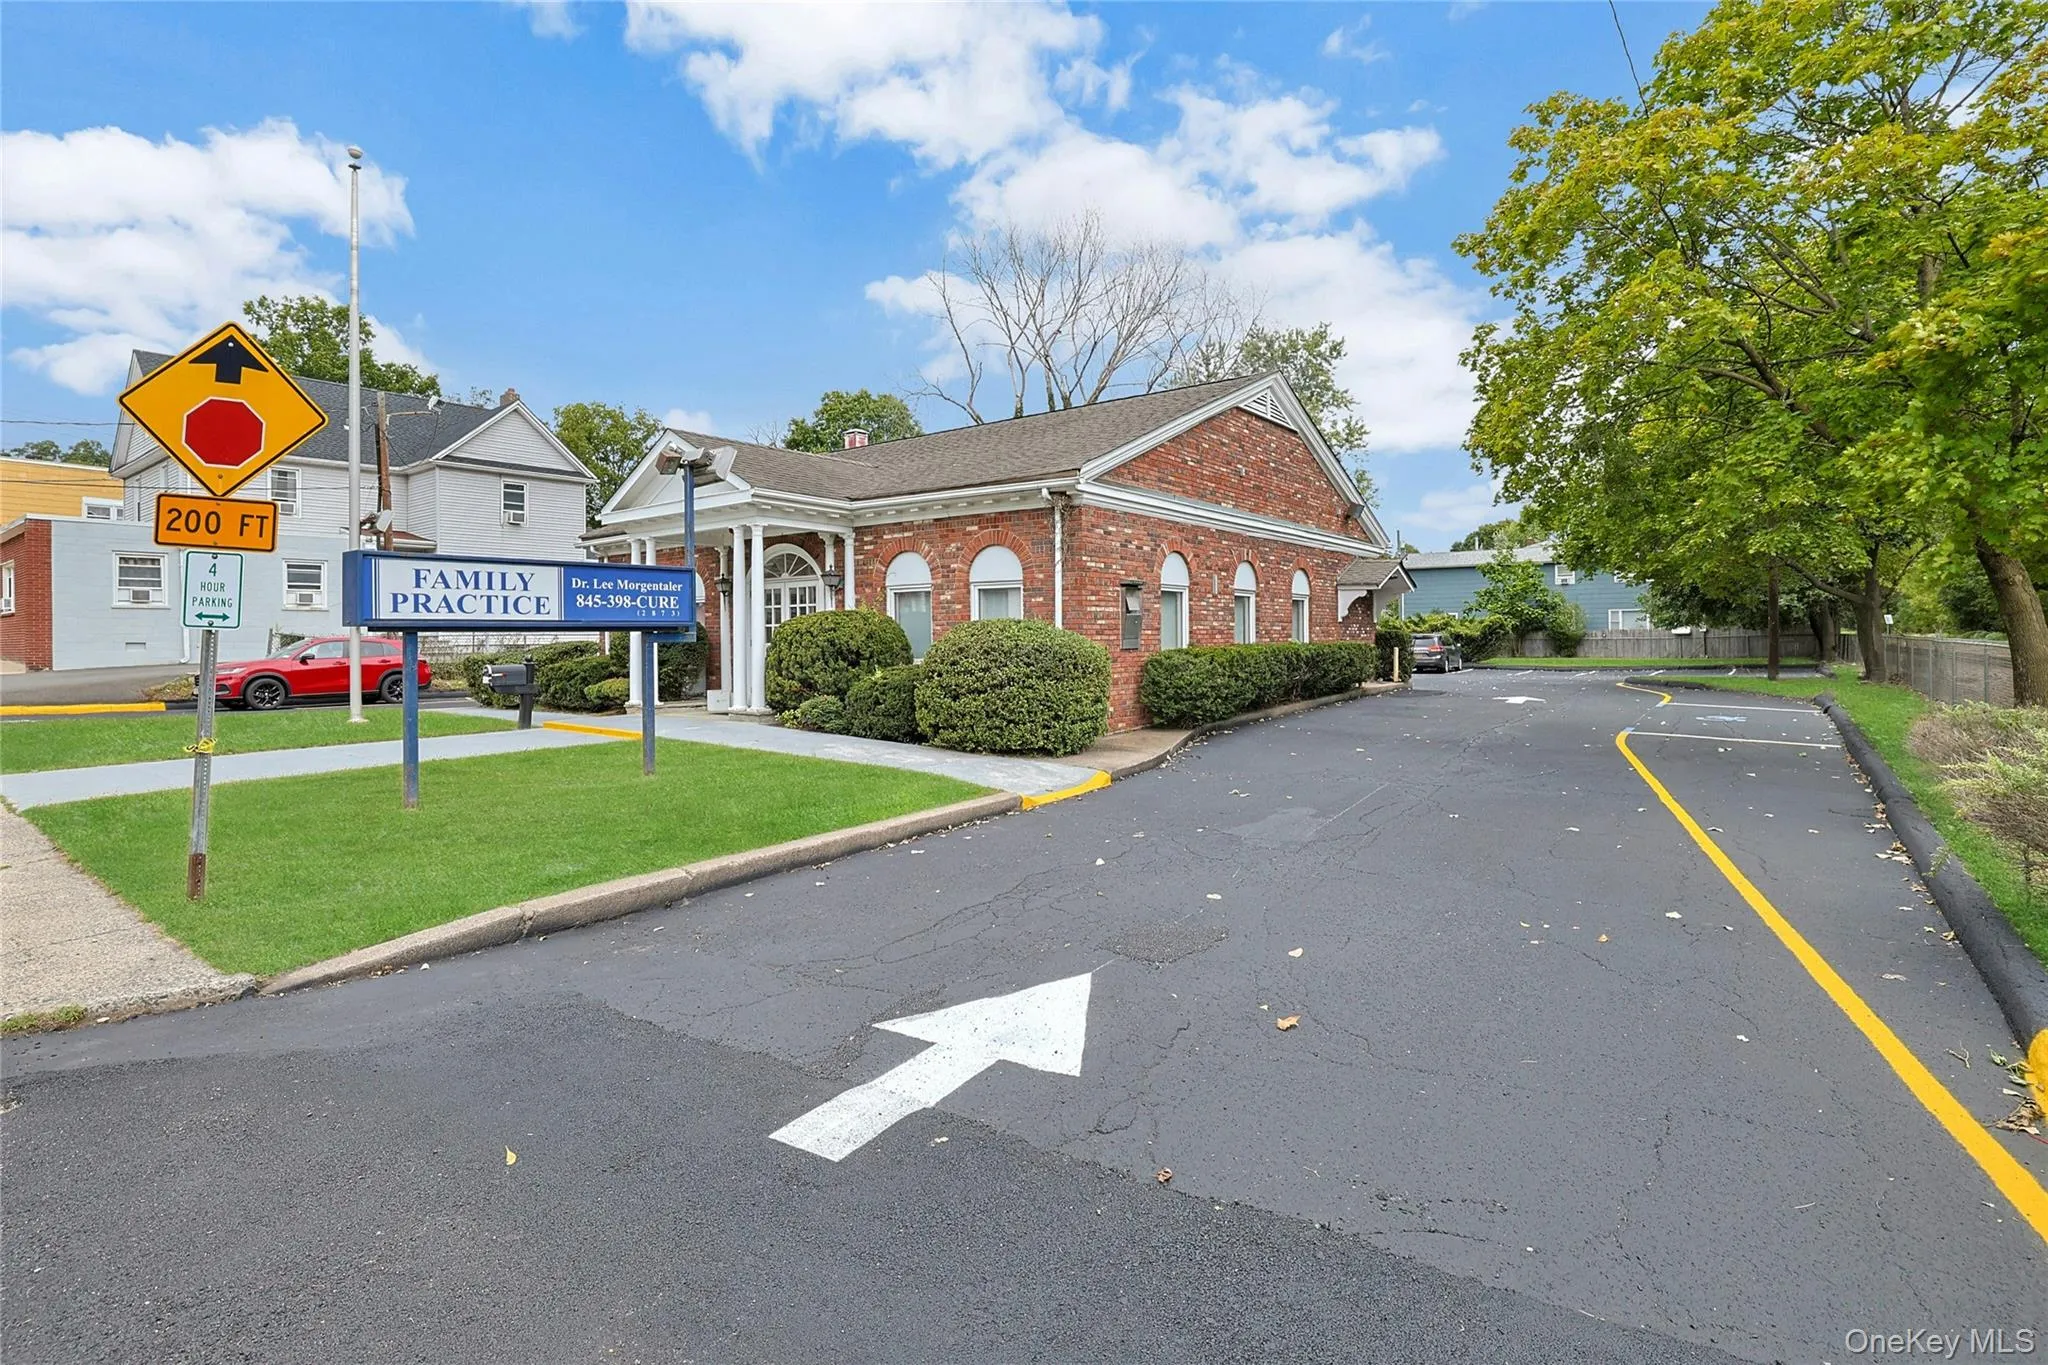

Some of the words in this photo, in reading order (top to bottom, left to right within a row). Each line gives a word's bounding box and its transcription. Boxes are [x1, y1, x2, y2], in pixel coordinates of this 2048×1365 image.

[166, 508, 221, 535] 200
[239, 514, 269, 538] FT
[208, 563, 217, 577] 4
[200, 581, 226, 593] HOUR
[412, 568, 535, 592] FAMILY
[571, 578, 590, 589] Dr.
[593, 579, 614, 590] Lee
[617, 579, 683, 593] Morgentaler
[192, 596, 233, 608] PARKING
[389, 592, 551, 615] PRACTICE
[576, 593, 680, 609] 845-398-CURE
